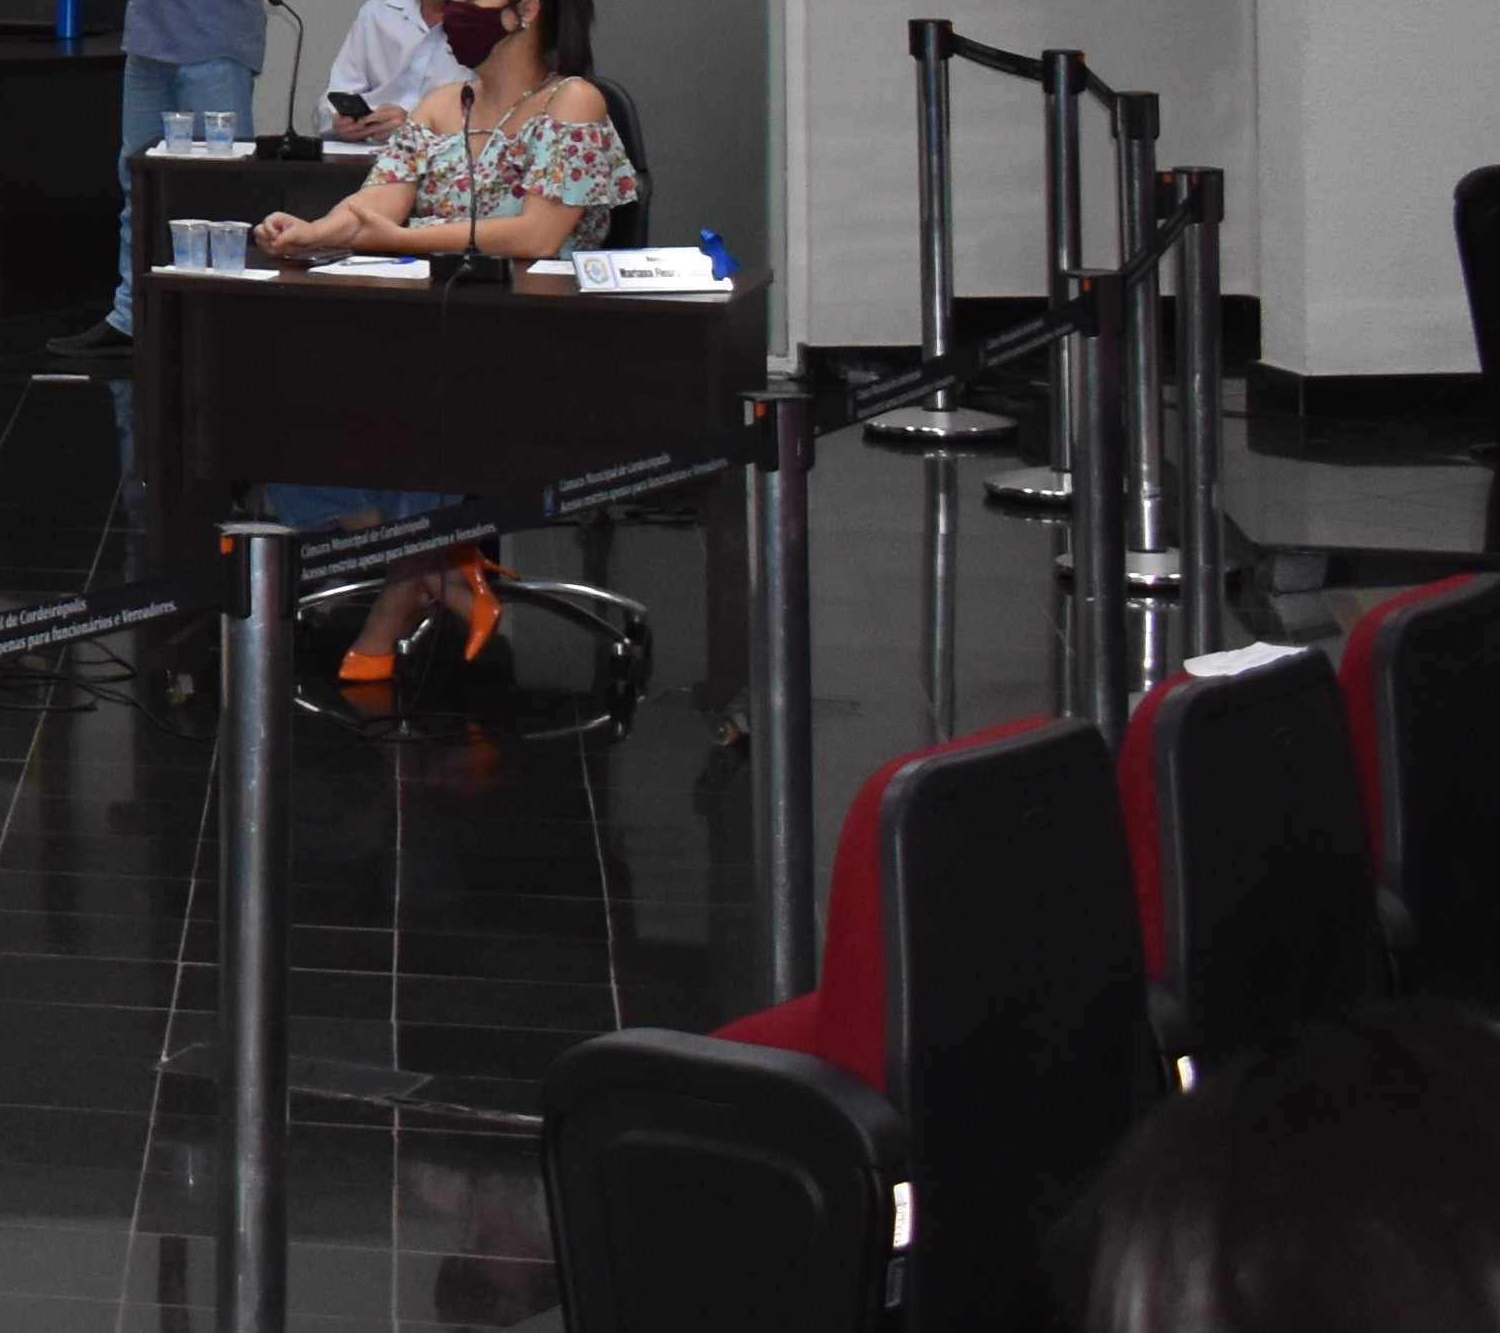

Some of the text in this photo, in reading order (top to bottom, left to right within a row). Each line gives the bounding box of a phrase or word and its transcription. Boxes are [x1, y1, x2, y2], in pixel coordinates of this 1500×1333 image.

[6, 610, 19, 630] de
[19, 597, 88, 628] Cordeirópolis
[27, 630, 52, 654] para
[51, 614, 113, 643] funcionários
[113, 614, 121, 628] e
[121, 599, 179, 625] Vereadores.
